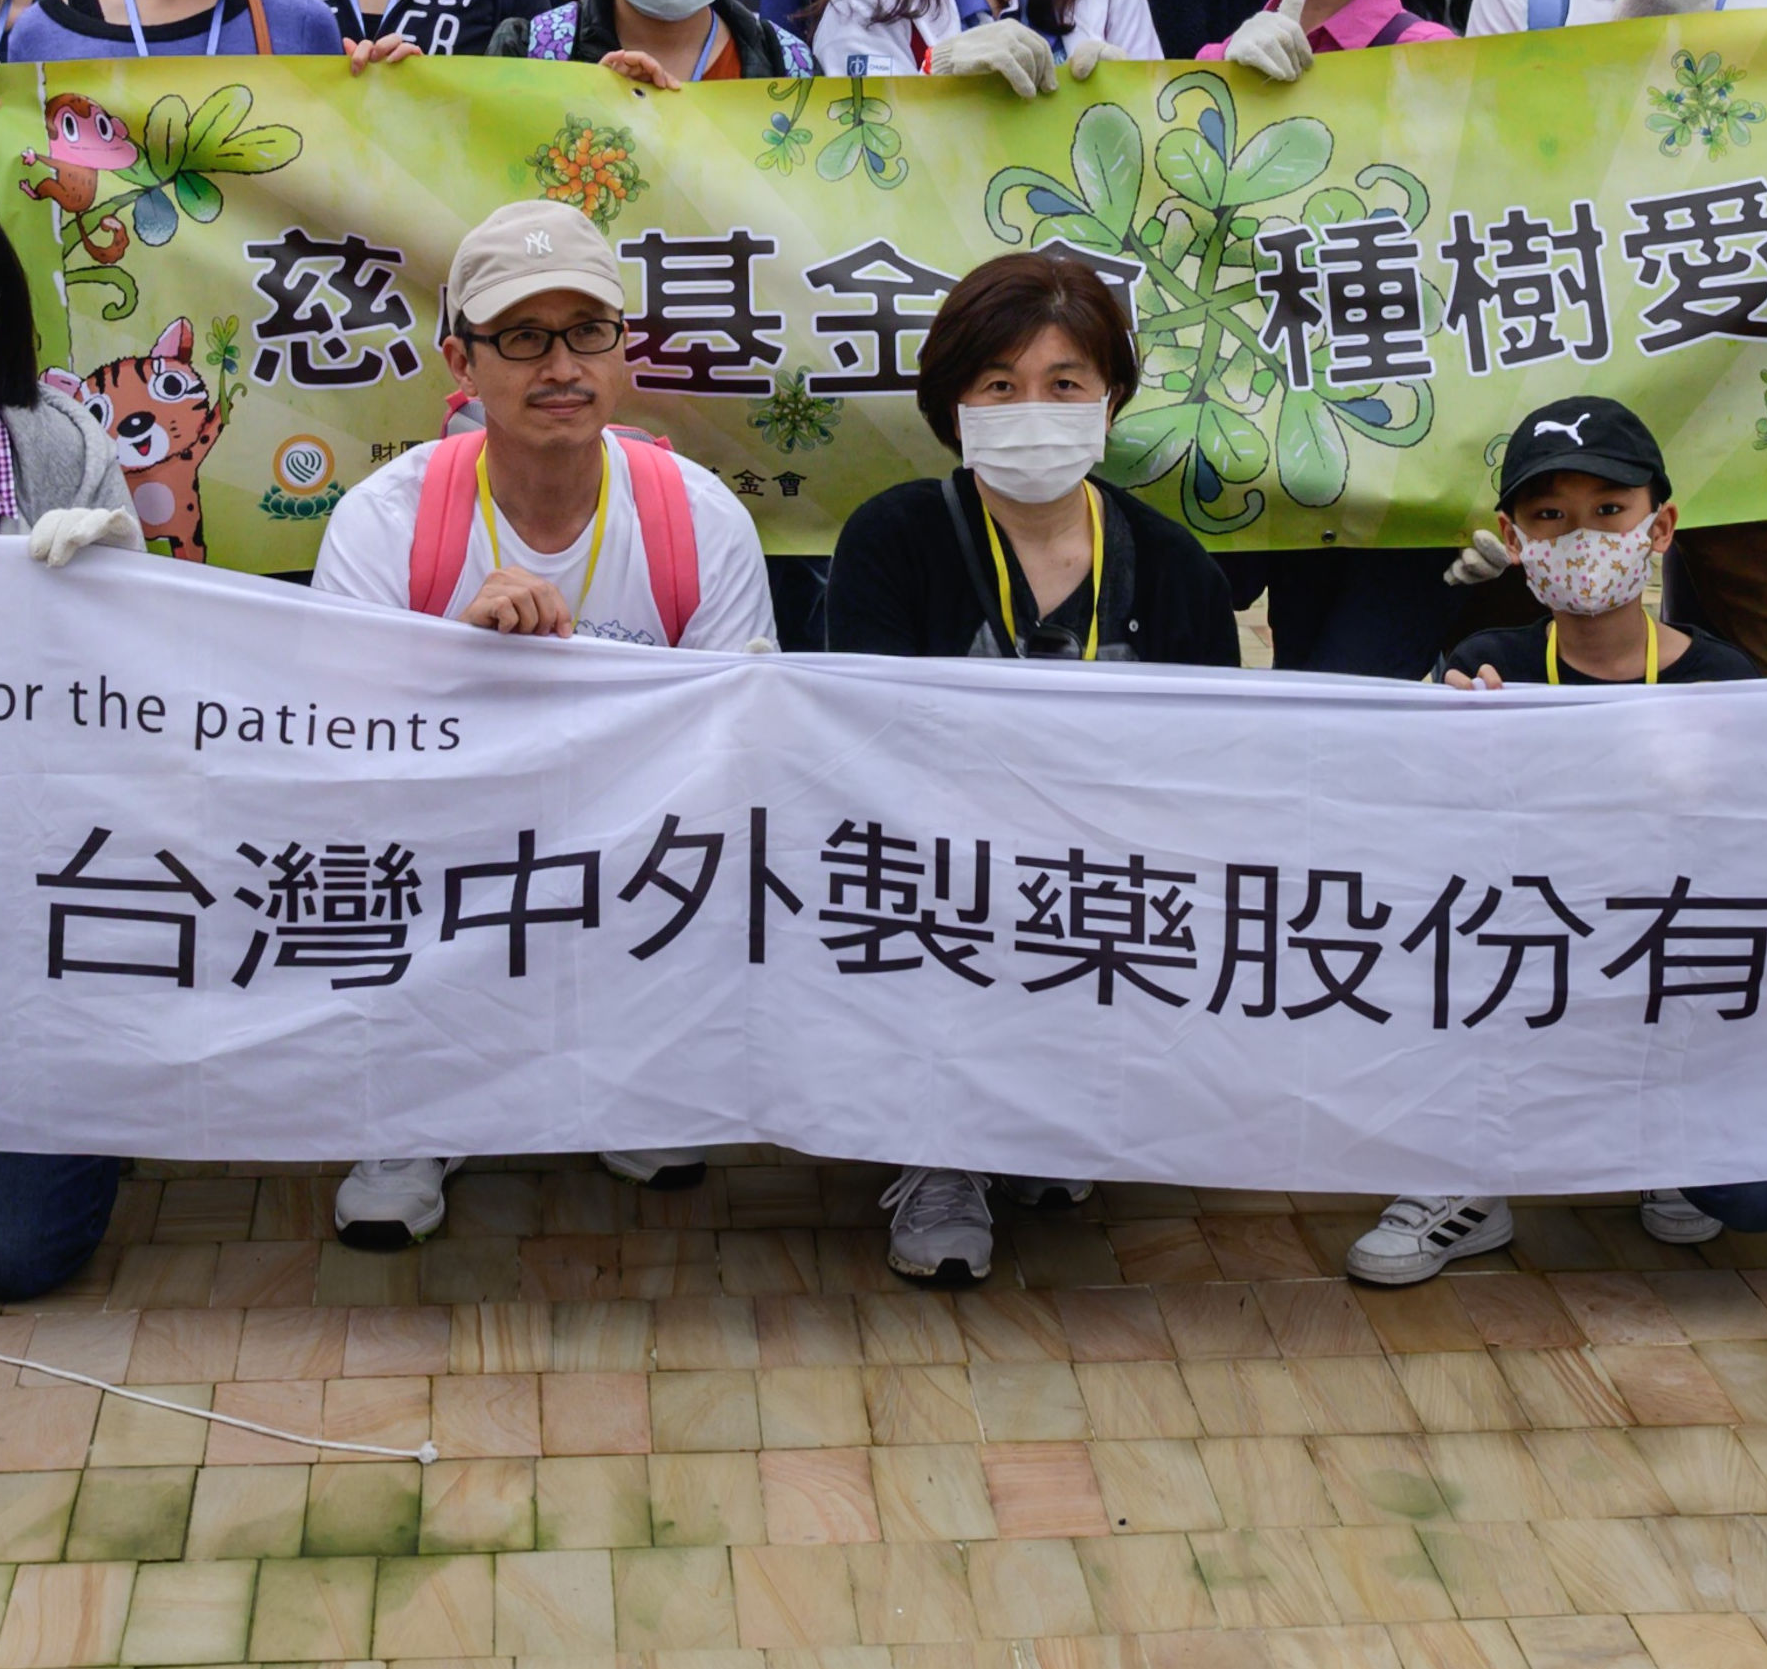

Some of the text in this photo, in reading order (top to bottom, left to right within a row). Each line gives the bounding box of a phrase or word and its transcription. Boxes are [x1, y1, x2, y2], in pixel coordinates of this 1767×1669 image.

[246, 229, 1143, 394] 慈基金
[68, 675, 166, 733] the
[195, 701, 460, 751] patients
